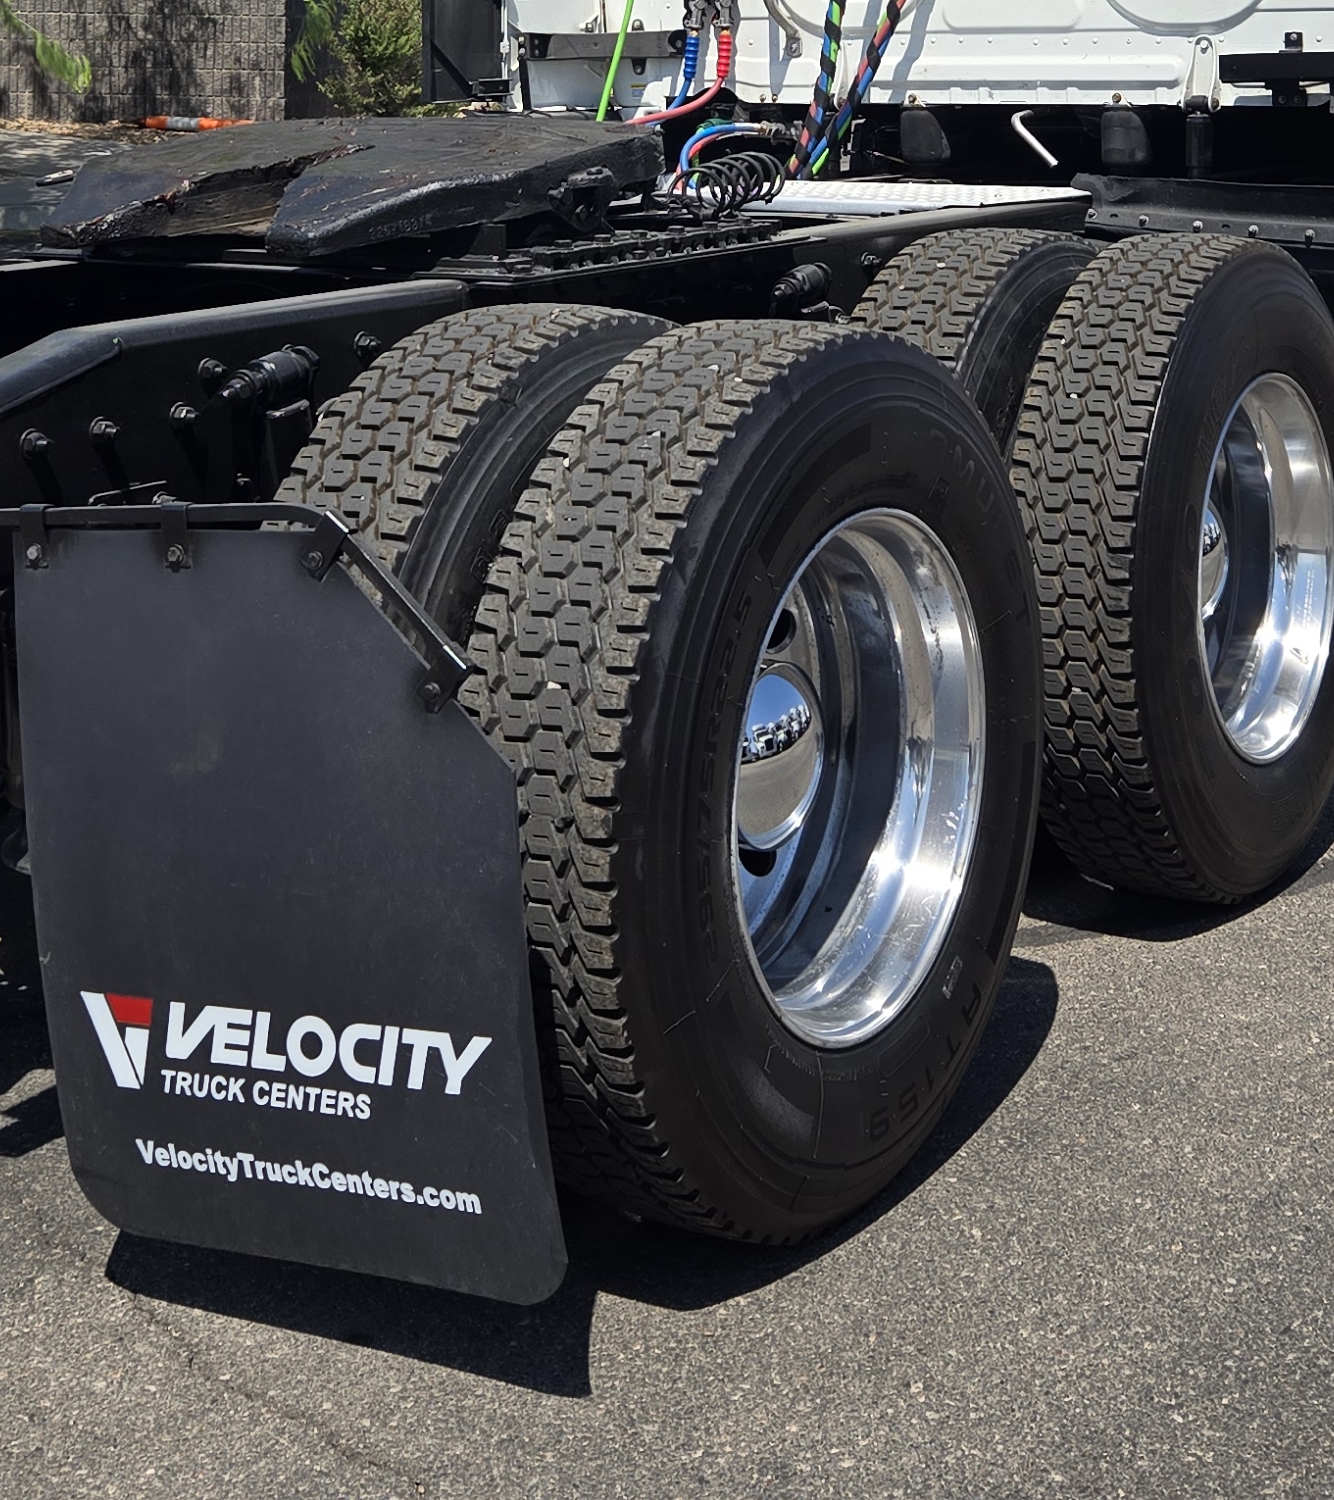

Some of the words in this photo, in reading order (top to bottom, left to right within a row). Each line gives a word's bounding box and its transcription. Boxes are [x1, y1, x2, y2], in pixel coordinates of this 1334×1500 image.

[165, 1001, 492, 1095] VELOCITY
[161, 1069, 245, 1104] TRUCK
[252, 1080, 371, 1120] CENTERS
[135, 1138, 483, 1215] VelocityTruckCenters.com
